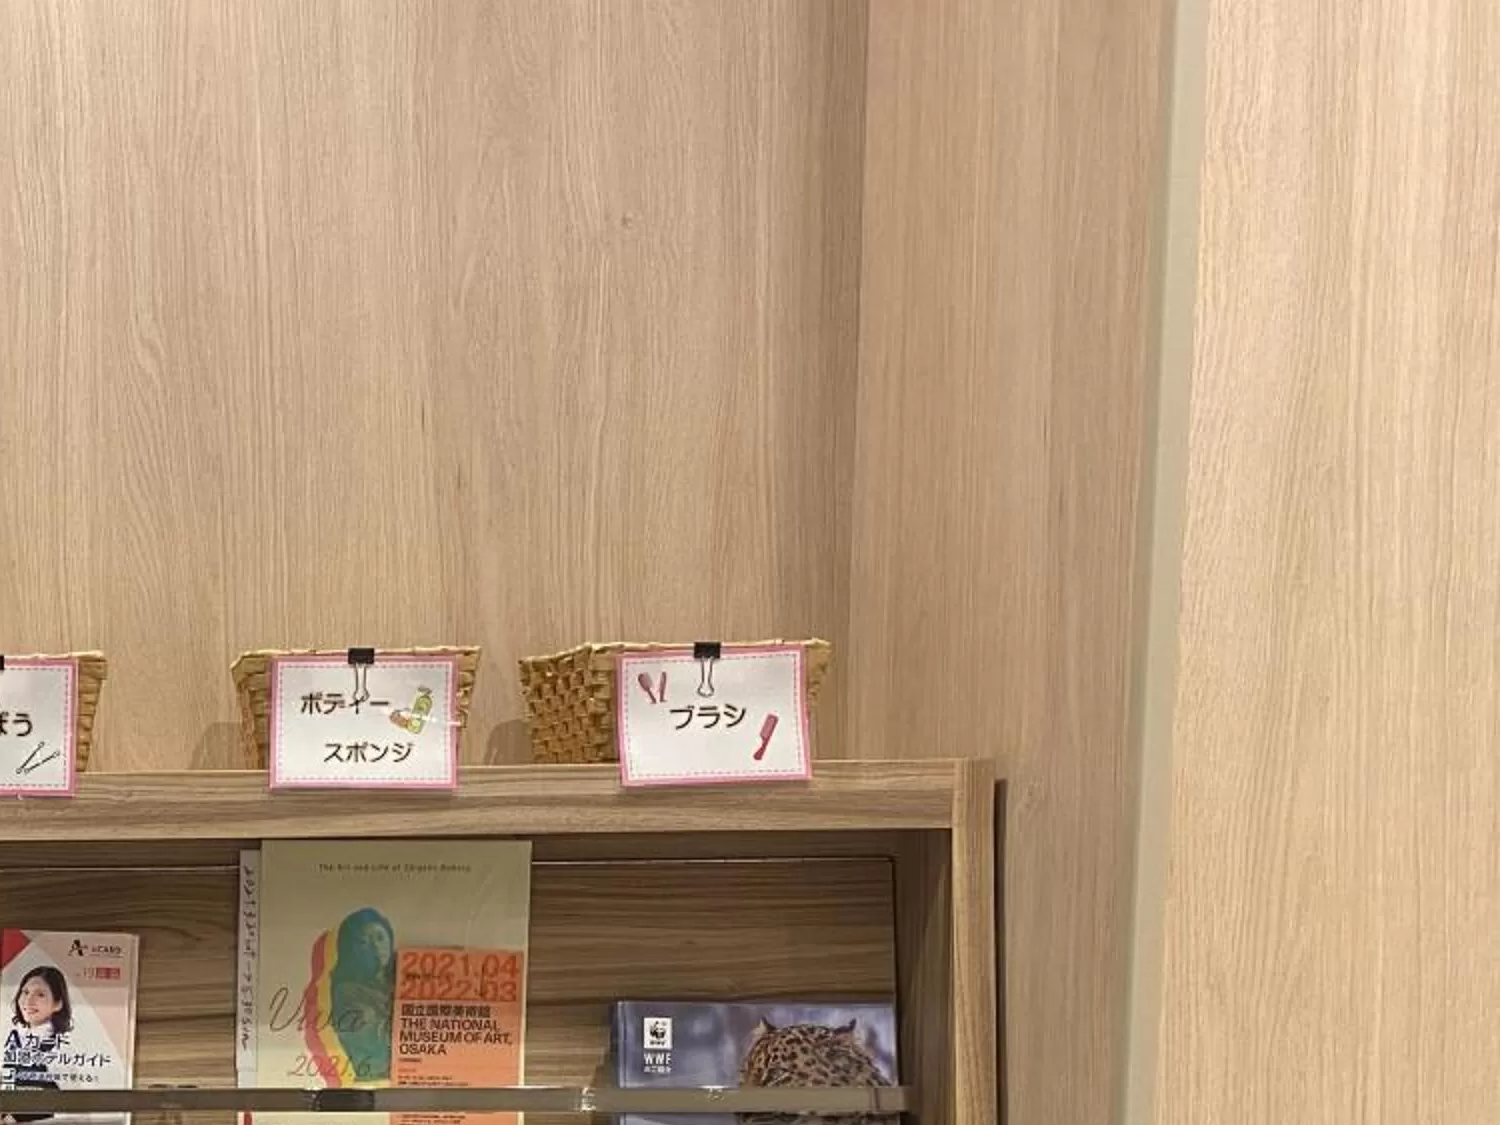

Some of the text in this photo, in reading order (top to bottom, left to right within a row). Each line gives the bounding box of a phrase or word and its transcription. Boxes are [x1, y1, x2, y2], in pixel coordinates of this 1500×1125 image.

[300, 691, 390, 716] ボディー
[669, 703, 747, 730] ブラシ
[324, 742, 414, 763] スポンジ
[400, 1018, 500, 1032] THE NATIONAL
[399, 1031, 462, 1043] MUSEUM
[463, 1031, 482, 1043] OF
[399, 1043, 448, 1055] OSAKA
[643, 1052, 671, 1065] WWF
